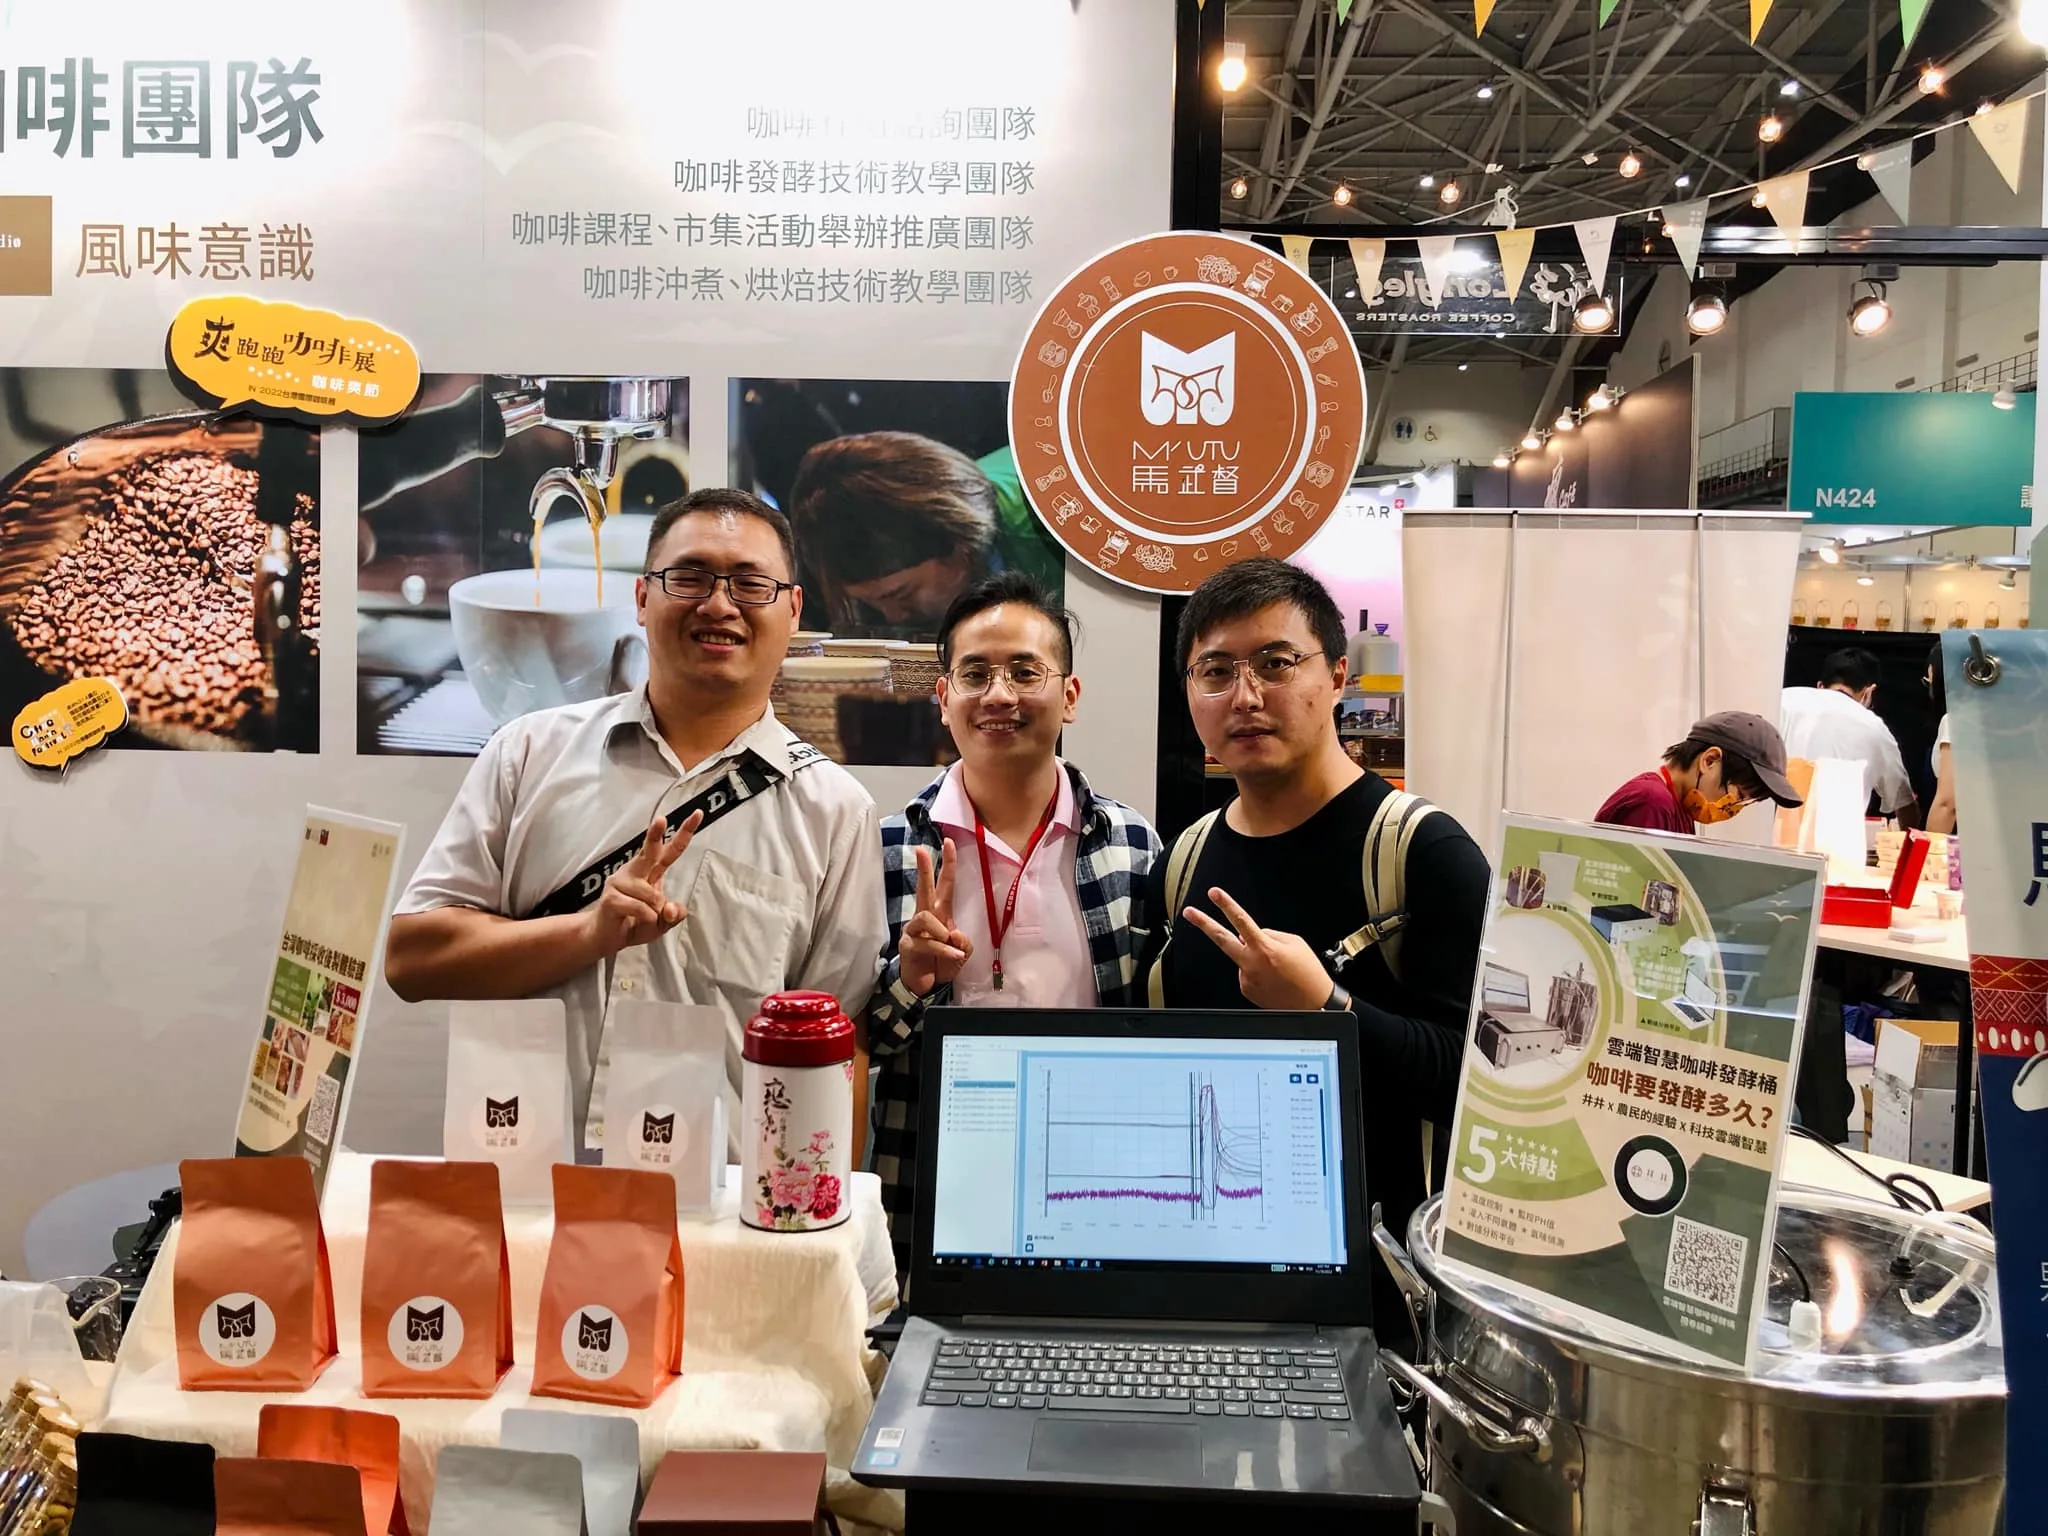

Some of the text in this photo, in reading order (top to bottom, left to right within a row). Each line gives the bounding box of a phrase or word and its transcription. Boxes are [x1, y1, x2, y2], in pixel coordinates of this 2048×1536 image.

[0, 57, 325, 160] 啡團隊
[674, 158, 1036, 196] 咖啡發酵技術教學團隊
[511, 210, 1035, 251] 咖啡課程、市集活動舉辦推廣團隊
[75, 221, 315, 282] 風味意識
[584, 264, 1034, 305] 咖啡沖煮、烘焙技術教學團隊
[1815, 487, 1877, 508] N424
[1606, 1036, 1778, 1096] 雲端智慧咖啡發酵桶
[1586, 1061, 1774, 1129] 咖啡要發酵多久?
[1689, 1123, 1768, 1155] 科技雲端智慧
[1500, 1146, 1558, 1181] 大特點
